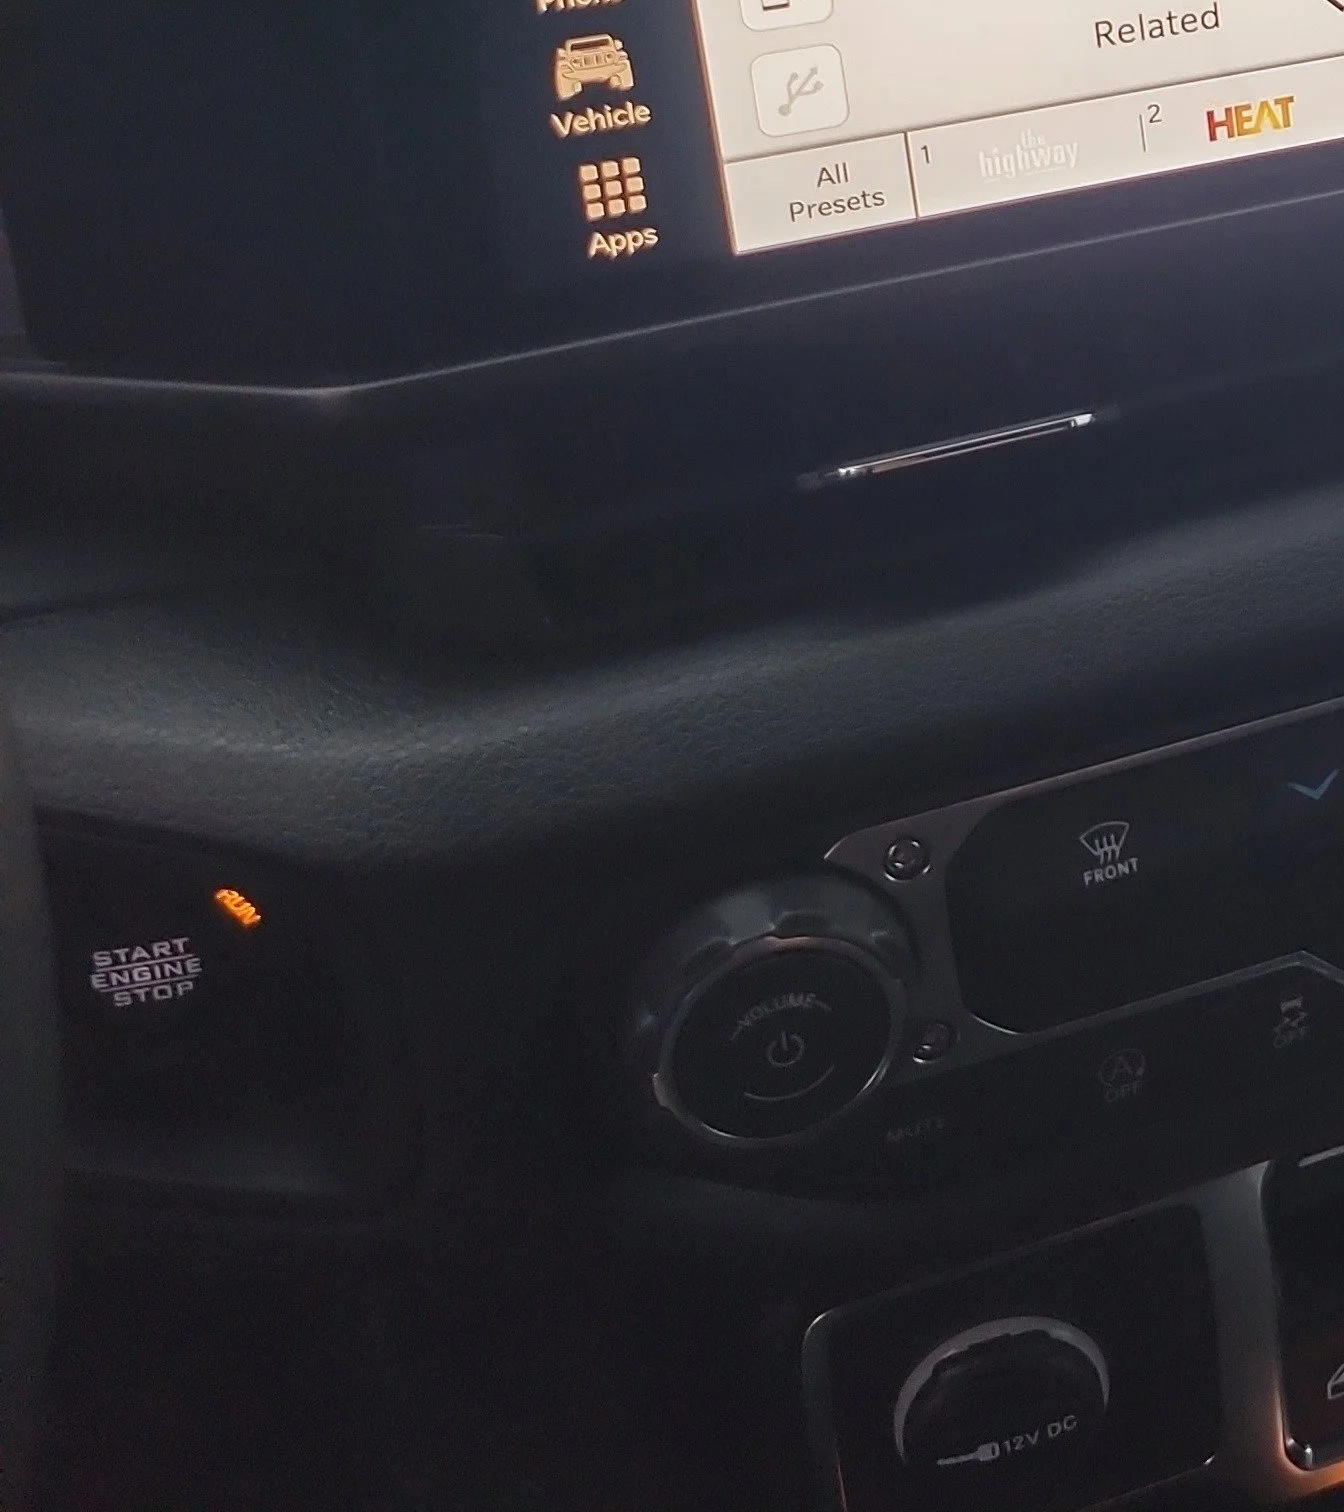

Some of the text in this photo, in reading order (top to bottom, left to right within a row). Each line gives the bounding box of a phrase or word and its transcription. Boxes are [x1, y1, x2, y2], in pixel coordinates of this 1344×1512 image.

[1093, 1, 1222, 50] Related
[550, 100, 652, 139] Vehicle
[1146, 102, 1164, 125] 2
[1205, 94, 1297, 143] HEAT
[920, 143, 931, 165] 1
[978, 140, 1079, 180] highway
[815, 162, 850, 189] All
[788, 188, 887, 223] Presets
[587, 226, 660, 262] Apps
[1081, 855, 1140, 888] FRONT
[93, 937, 190, 968] START
[91, 957, 203, 989] ENGINE
[112, 979, 195, 1007] STOP
[1002, 1414, 1077, 1455] 12V DC
